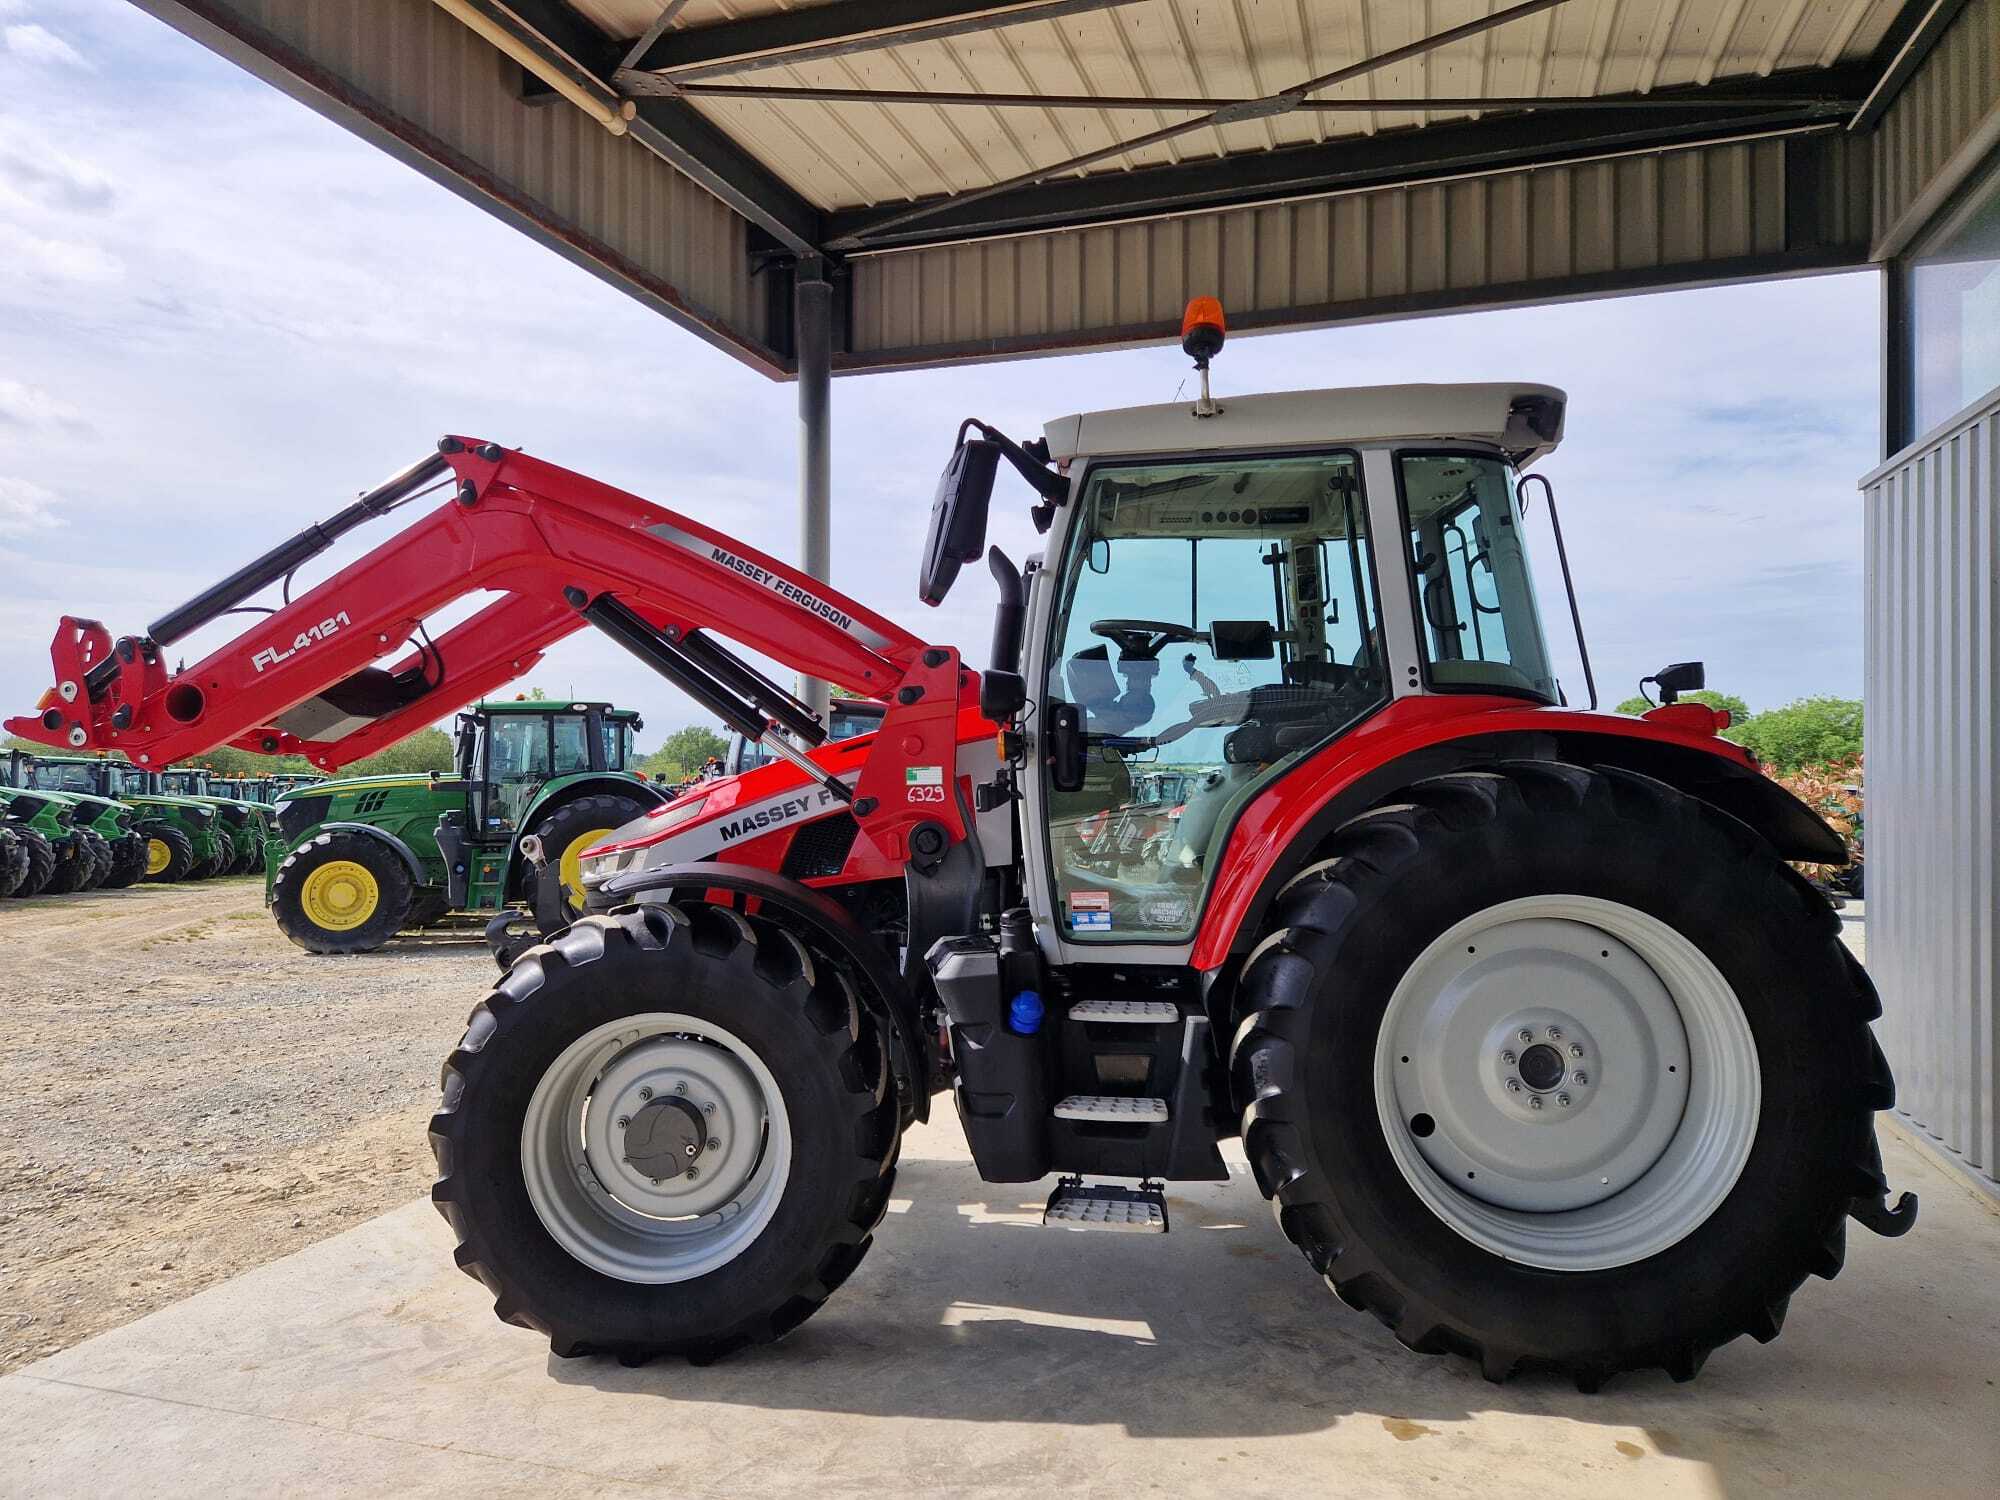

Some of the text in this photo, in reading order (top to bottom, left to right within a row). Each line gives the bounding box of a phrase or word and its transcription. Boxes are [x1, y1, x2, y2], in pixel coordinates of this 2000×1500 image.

[711, 548, 852, 630] MASSEY FERGUSON
[251, 610, 352, 673] FL.4121
[719, 795, 810, 842] MASSEY
[907, 786, 945, 803] 6329
